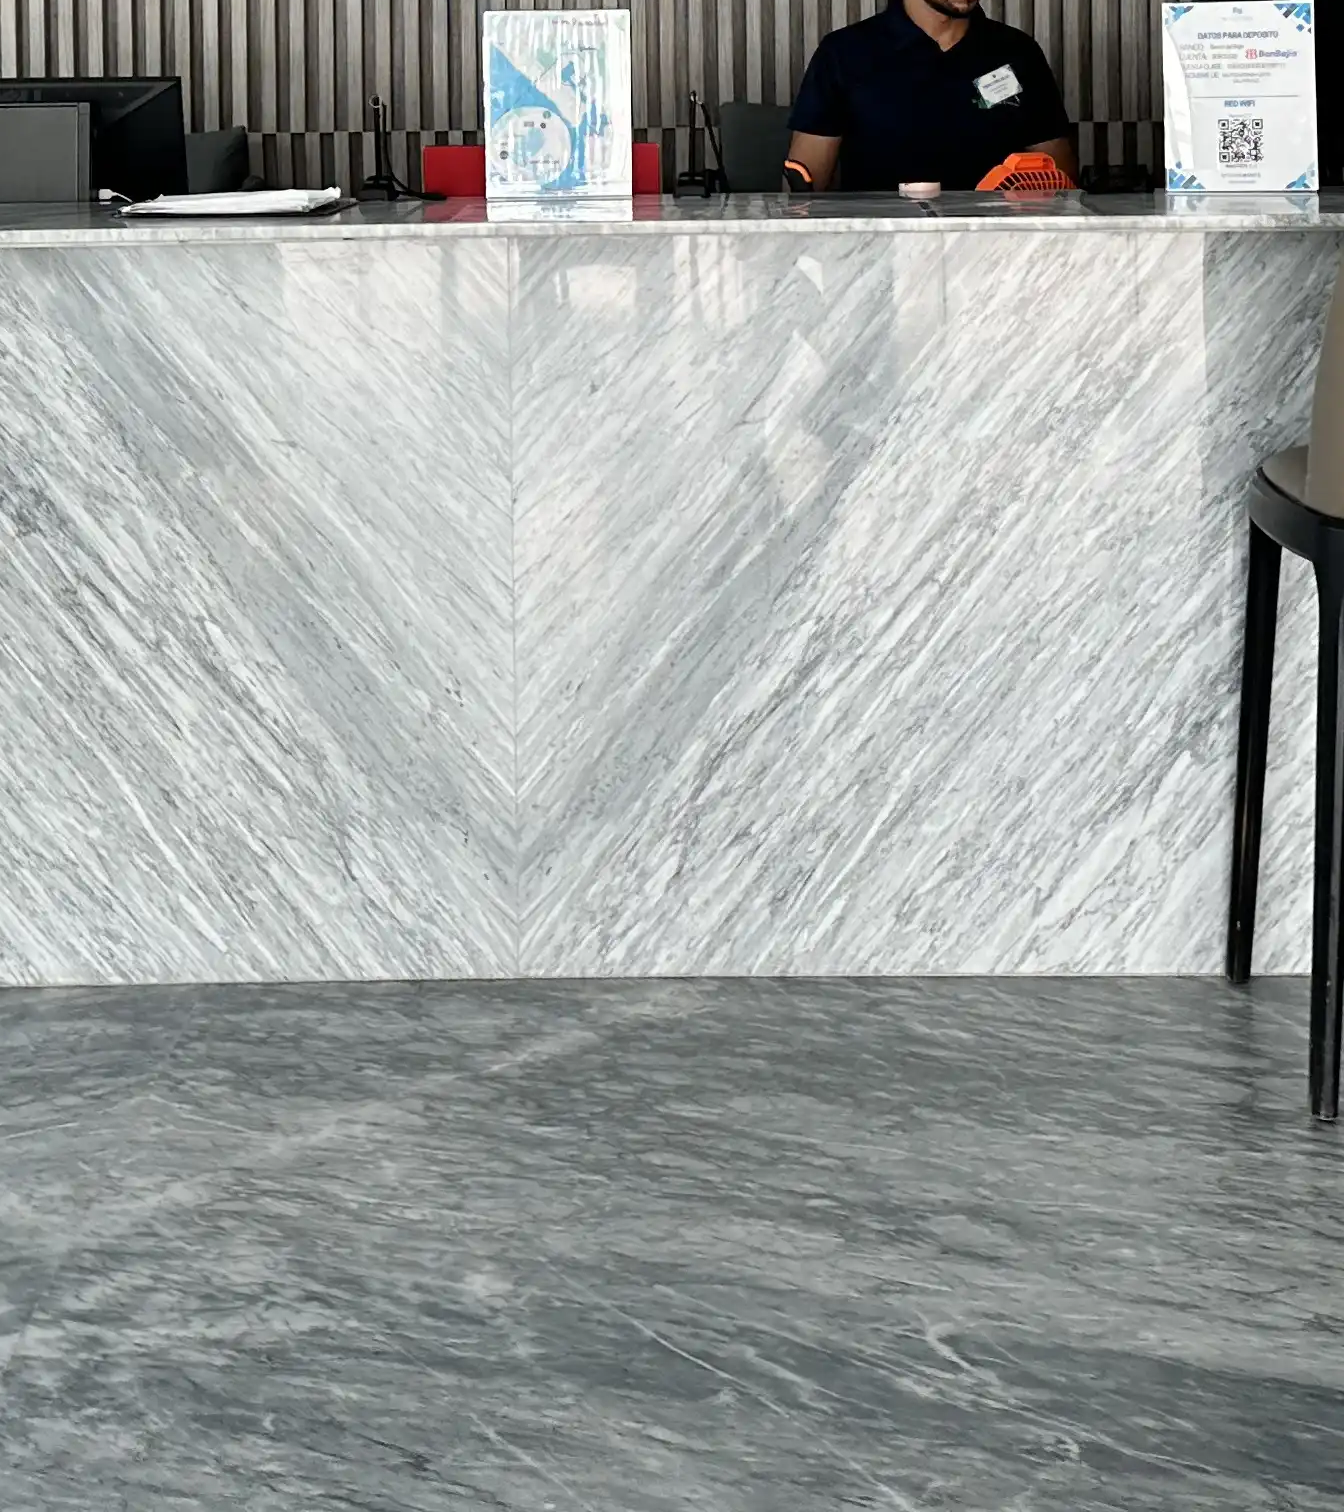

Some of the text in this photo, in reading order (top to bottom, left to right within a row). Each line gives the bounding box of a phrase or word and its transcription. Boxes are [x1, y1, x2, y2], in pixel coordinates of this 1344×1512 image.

[1197, 32, 1221, 40] DATOS
[1222, 31, 1242, 39] PARA
[1224, 100, 1238, 108] RED
